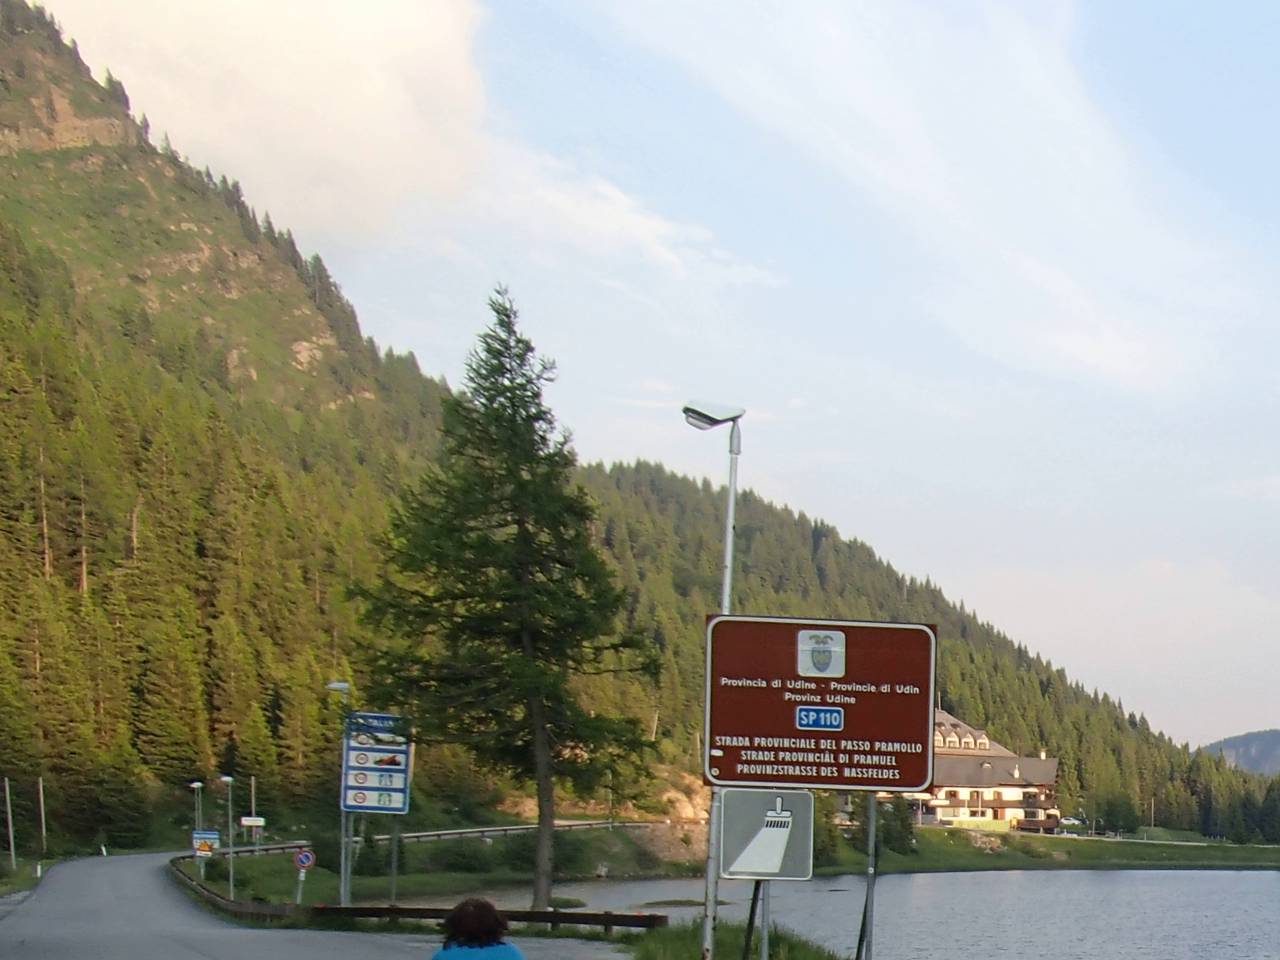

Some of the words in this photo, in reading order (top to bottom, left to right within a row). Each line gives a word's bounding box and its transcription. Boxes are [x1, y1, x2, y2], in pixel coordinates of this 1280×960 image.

[721, 677, 767, 688] Provincia
[772, 679, 782, 688] di
[787, 680, 816, 689] Udine
[830, 682, 877, 693] Provincie
[880, 684, 891, 693] di
[896, 685, 920, 694] Udin
[784, 692, 821, 702] Provinz
[826, 695, 856, 704] Udine
[800, 711, 817, 725] SP
[820, 712, 840, 726] 110
[715, 736, 750, 747] STRADA
[754, 737, 816, 749] PROVINCIALE
[820, 740, 836, 750] DEL
[841, 740, 871, 750] PASSO
[875, 741, 922, 753] PRAMOLLO
[741, 750, 775, 761] STRADE
[839, 754, 849, 764] DI
[853, 755, 897, 766] PRAMUEL
[737, 764, 817, 776] PROVINZSTRASSE
[820, 767, 838, 776] DES
[844, 768, 900, 779] NASSFELDES
